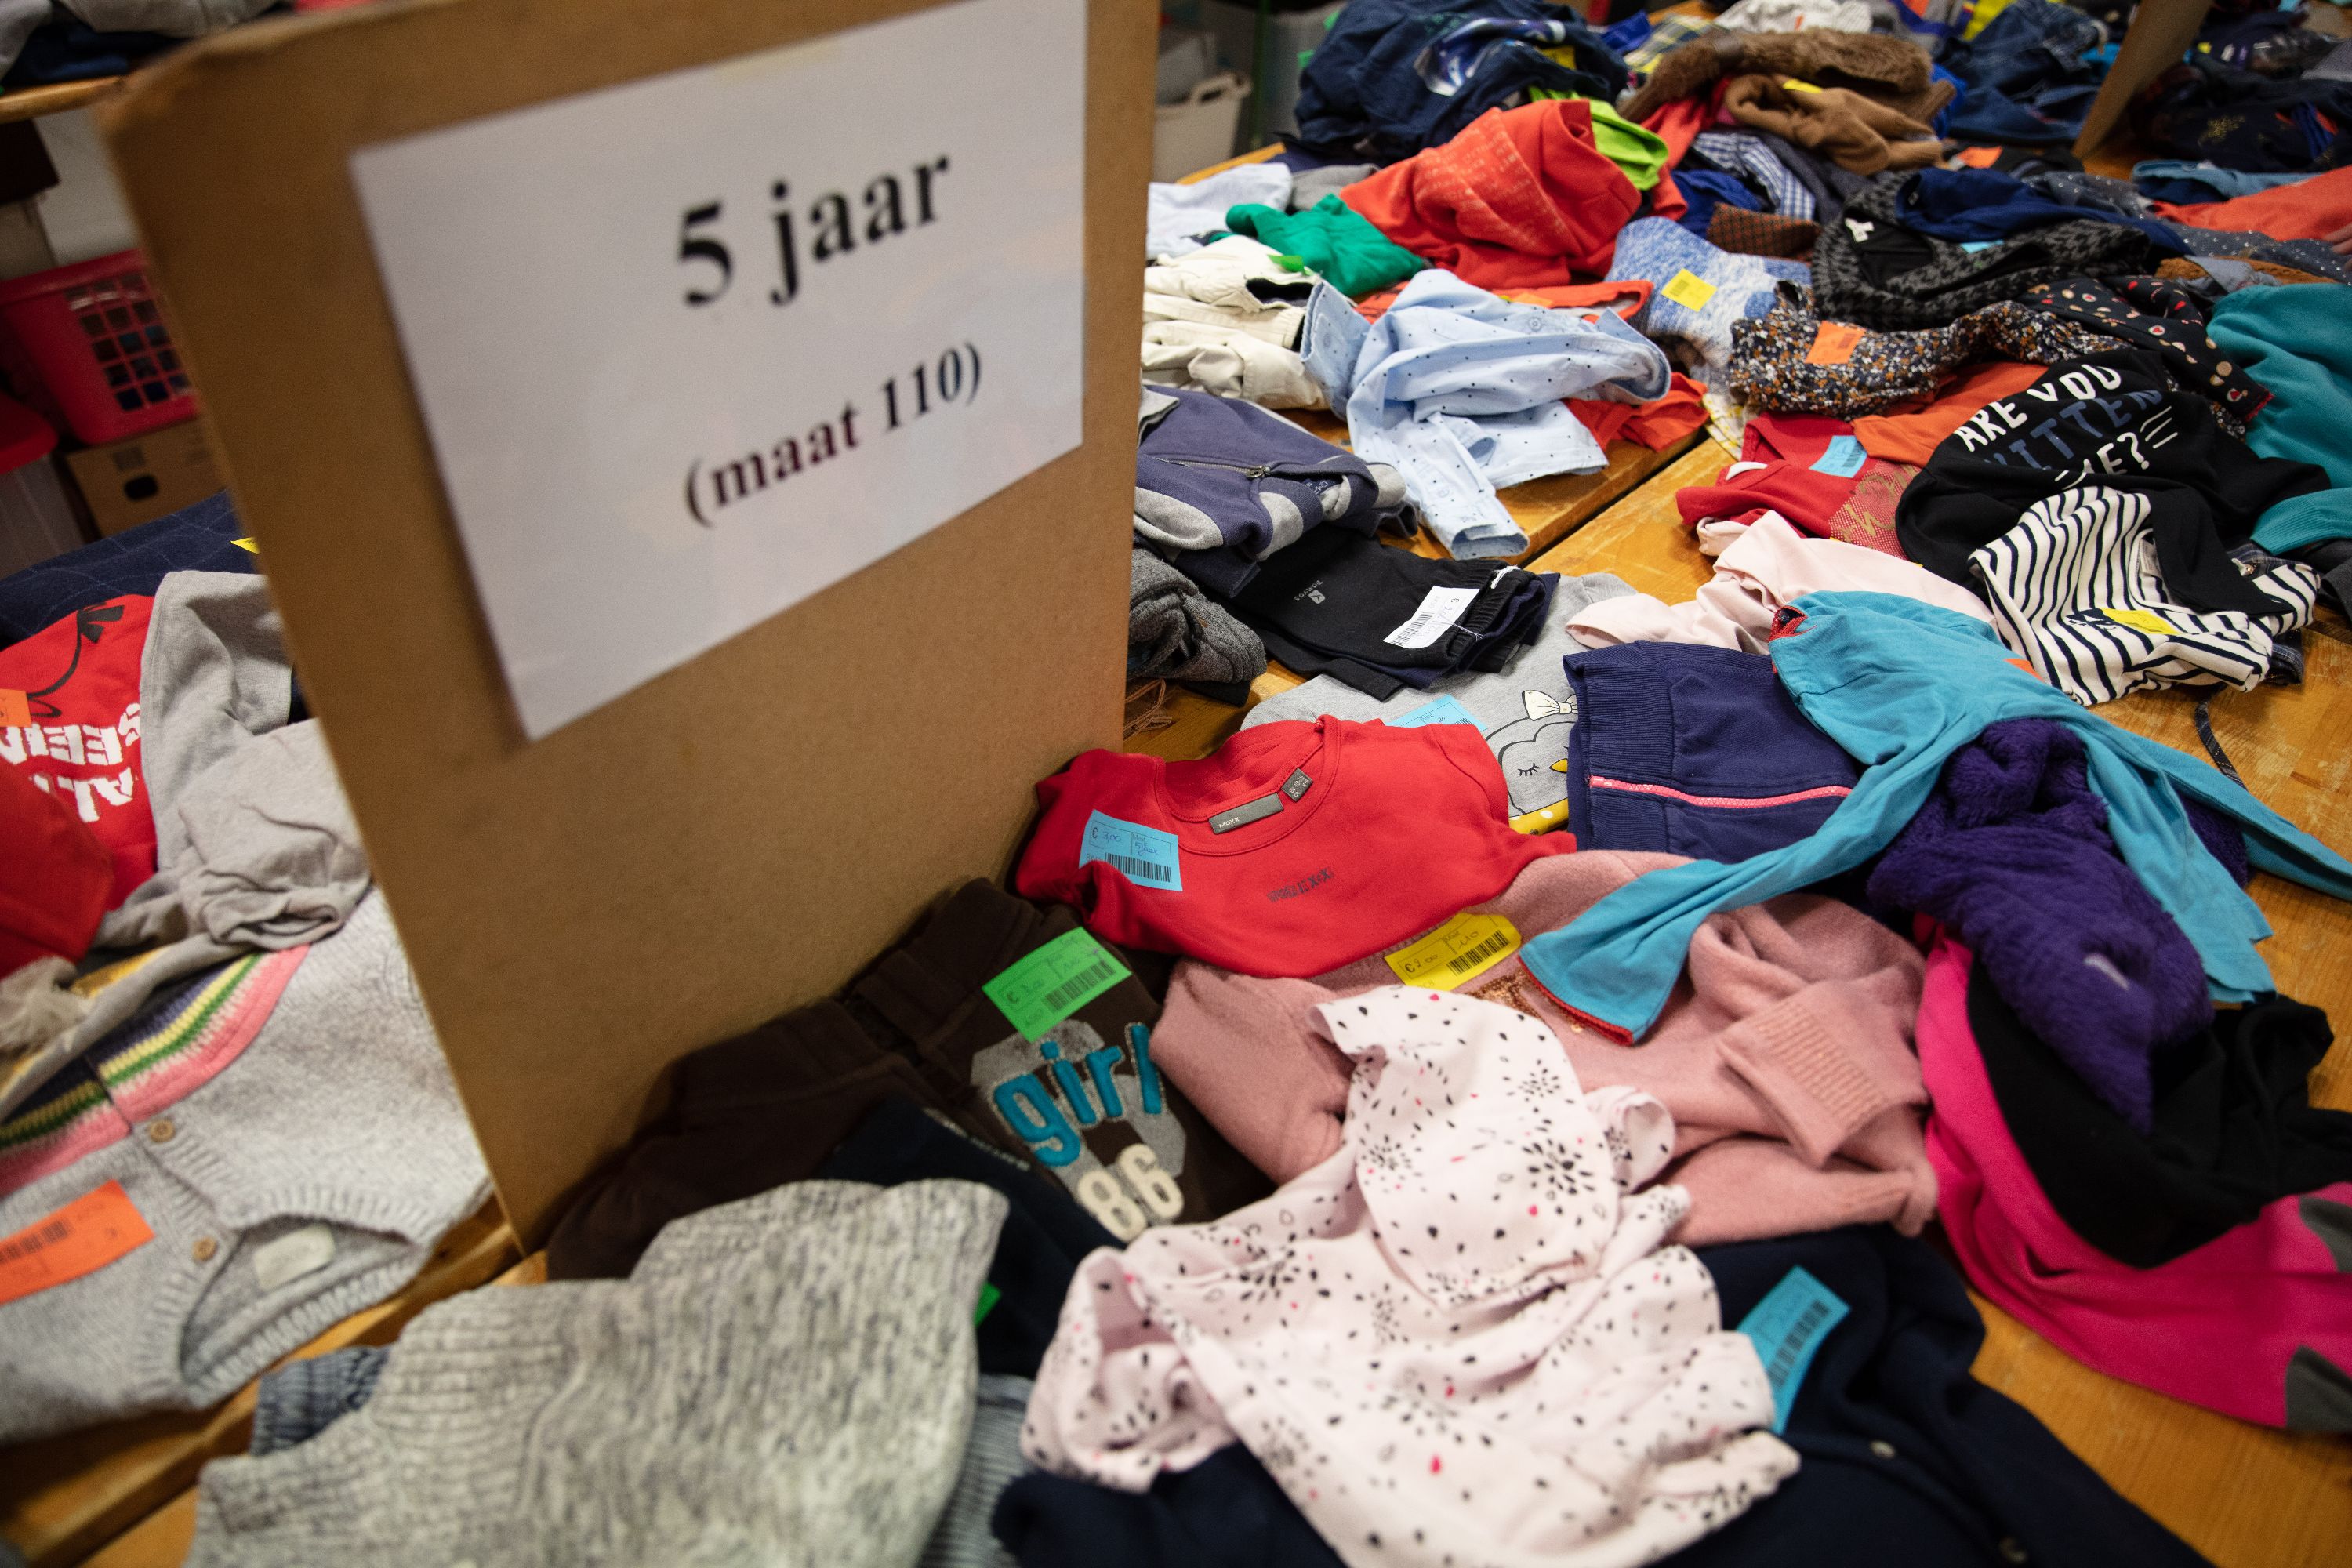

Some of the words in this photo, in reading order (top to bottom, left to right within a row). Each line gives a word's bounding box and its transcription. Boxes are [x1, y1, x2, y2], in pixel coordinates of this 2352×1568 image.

[679, 200, 733, 307] 5
[769, 154, 951, 307] jaar
[683, 400, 861, 528] (maat
[880, 340, 983, 434] 110)
[1953, 401, 2028, 452] ARE
[2026, 363, 2122, 402] YOU
[1983, 389, 2163, 470] ITTEN
[2081, 431, 2150, 476] E?
[1294, 580, 1323, 601] DOMYOS
[33, 766, 134, 823] AL
[1091, 826, 1098, 840] €
[993, 1023, 1163, 1167] girl
[1077, 1142, 1185, 1243] 86
